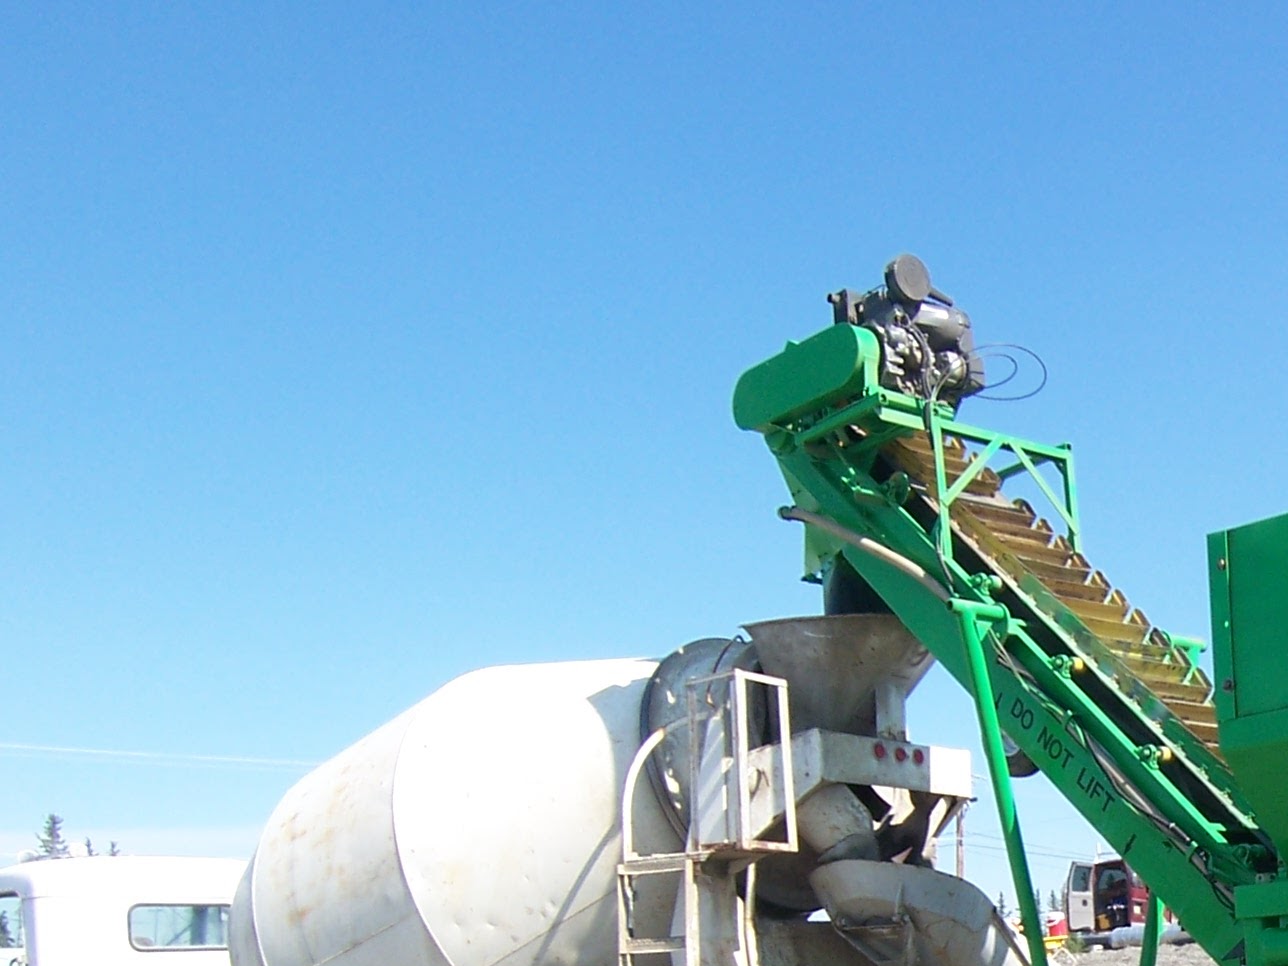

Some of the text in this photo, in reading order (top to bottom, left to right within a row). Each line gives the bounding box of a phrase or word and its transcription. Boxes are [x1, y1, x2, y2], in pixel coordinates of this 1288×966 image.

[1010, 697, 1115, 812] DO NOT LIFT
